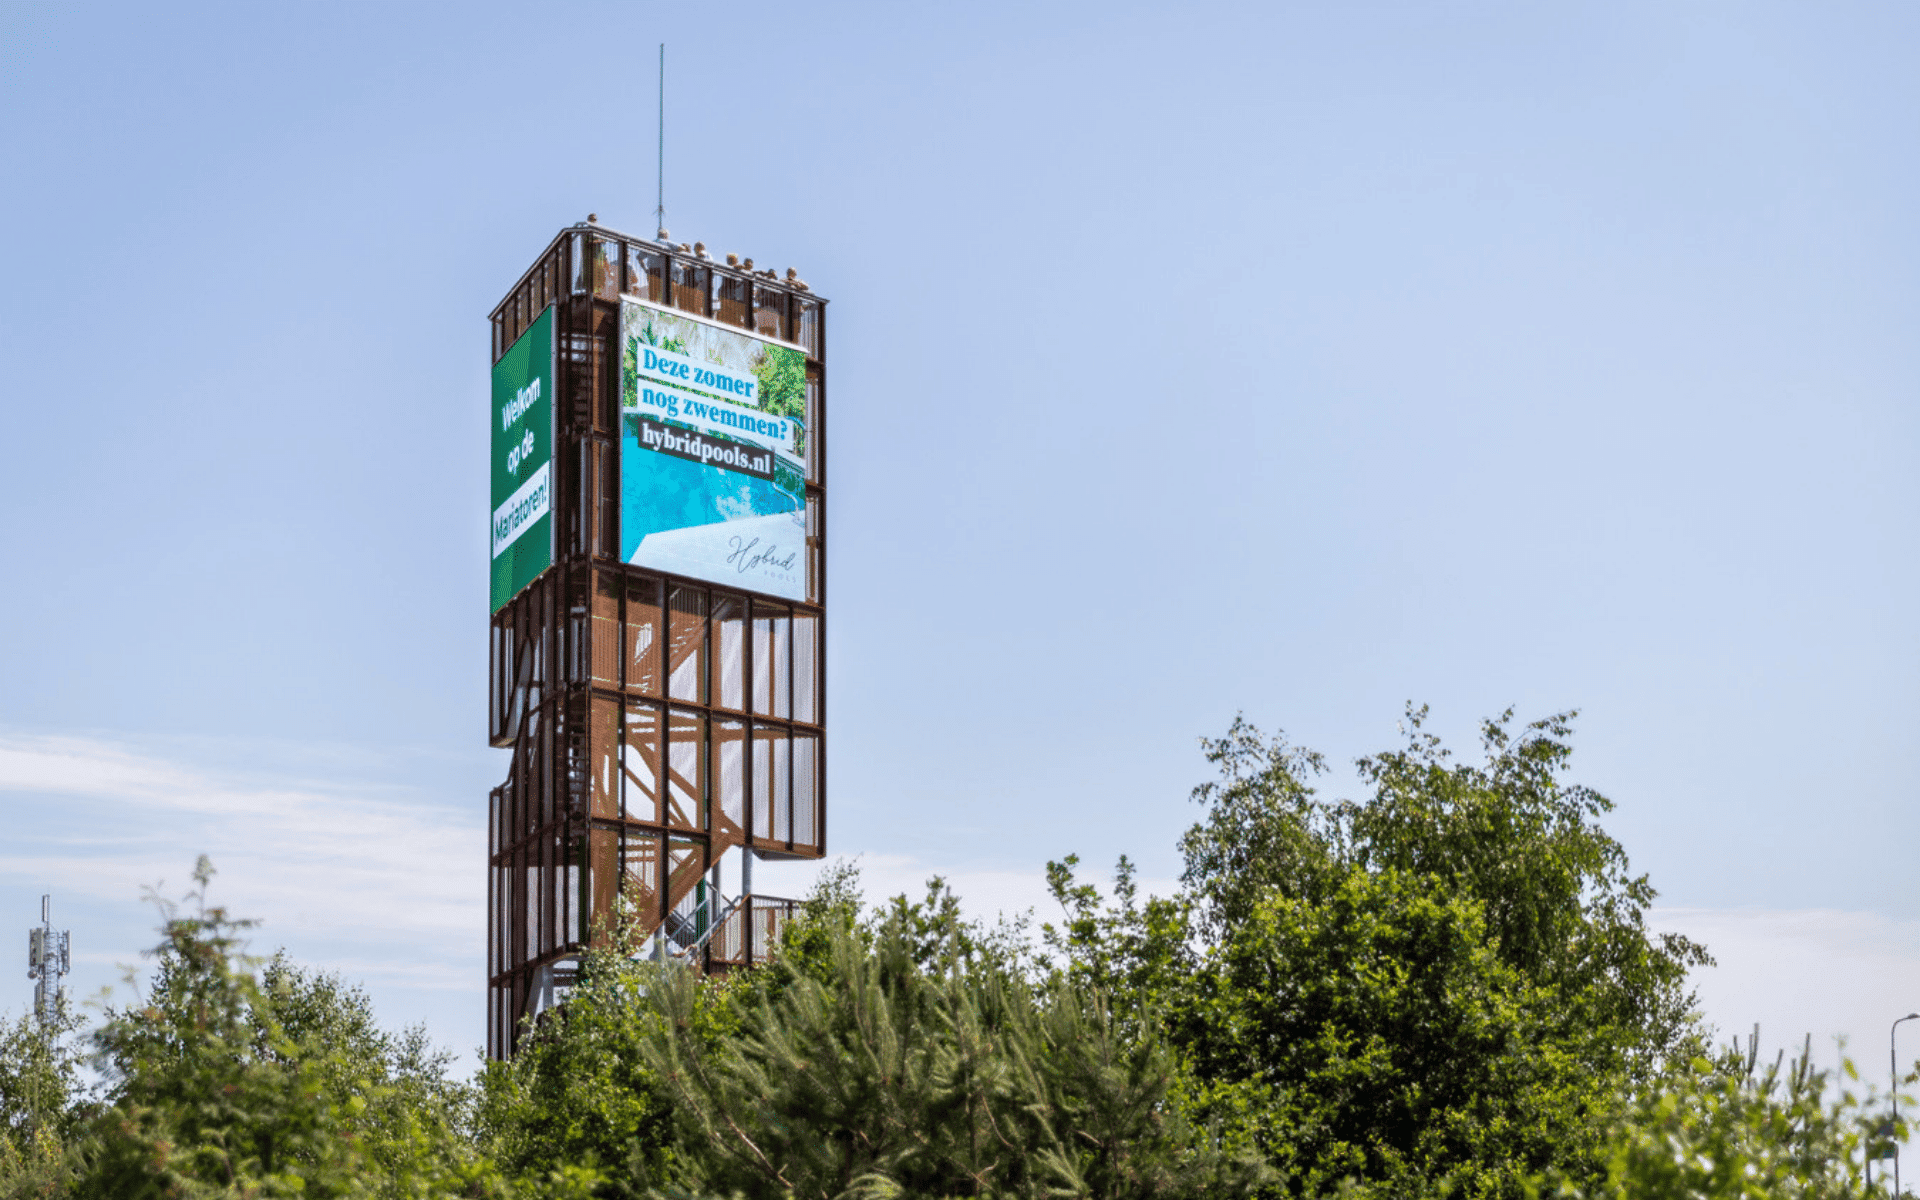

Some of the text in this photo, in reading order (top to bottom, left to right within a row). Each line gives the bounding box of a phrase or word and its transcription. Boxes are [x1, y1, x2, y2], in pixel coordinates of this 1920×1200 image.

[643, 349, 754, 398] Deze zomer
[502, 376, 541, 432] Welkom
[642, 388, 787, 440] nog zwemmen?
[507, 428, 534, 476] op de
[642, 422, 771, 474] hybridpools.nl
[495, 475, 547, 547] Mariatoren!
[727, 536, 796, 573] Hybrid
